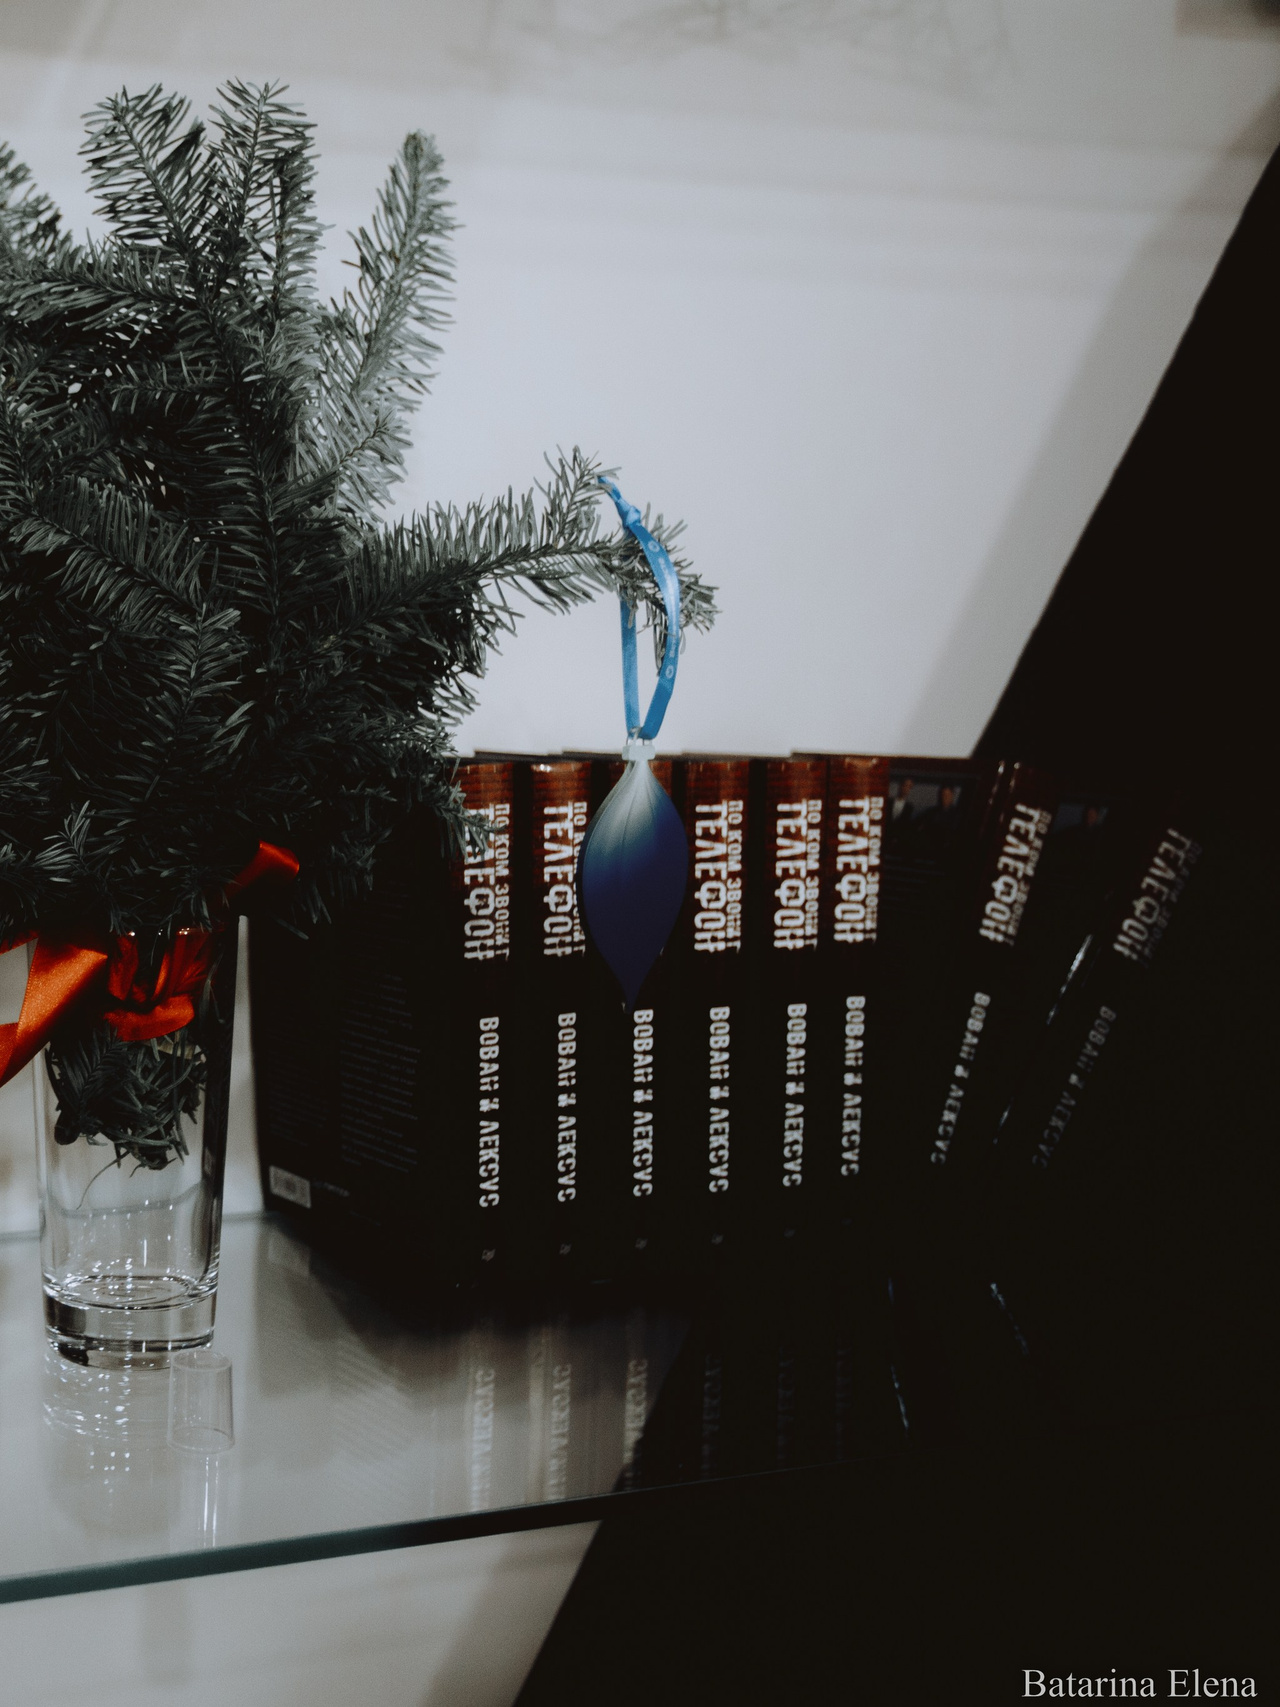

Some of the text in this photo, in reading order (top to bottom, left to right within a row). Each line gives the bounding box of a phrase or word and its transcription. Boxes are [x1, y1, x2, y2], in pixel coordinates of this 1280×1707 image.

[543, 801, 574, 958] ТЕЛЕФОН
[694, 799, 728, 953] ТЕЛЕФОН
[773, 798, 808, 951] ТЕЛЕФОН
[834, 795, 870, 944] ТЕЛЕФОН
[979, 802, 1040, 944] ТЕЛЕФОН
[1113, 827, 1192, 962] ТЕЛЕФОН
[479, 1016, 500, 1091] ВОВАН
[557, 1012, 577, 1087] ВОВАН
[633, 1008, 654, 1083] ВОВАН
[709, 1006, 731, 1080] ВОВАН
[786, 1003, 807, 1076] ВОВАН
[844, 995, 866, 1067] ВОВАН
[479, 1120, 500, 1208] ЛЕКСУС
[557, 1115, 577, 1203] ЛЕКСУС
[632, 1110, 654, 1197] ЛЕКСУС
[708, 1107, 730, 1193] ЛЕКСУС
[782, 1102, 805, 1187] ЛЕКСУС
[840, 1092, 862, 1176] ЛЕКСУС
